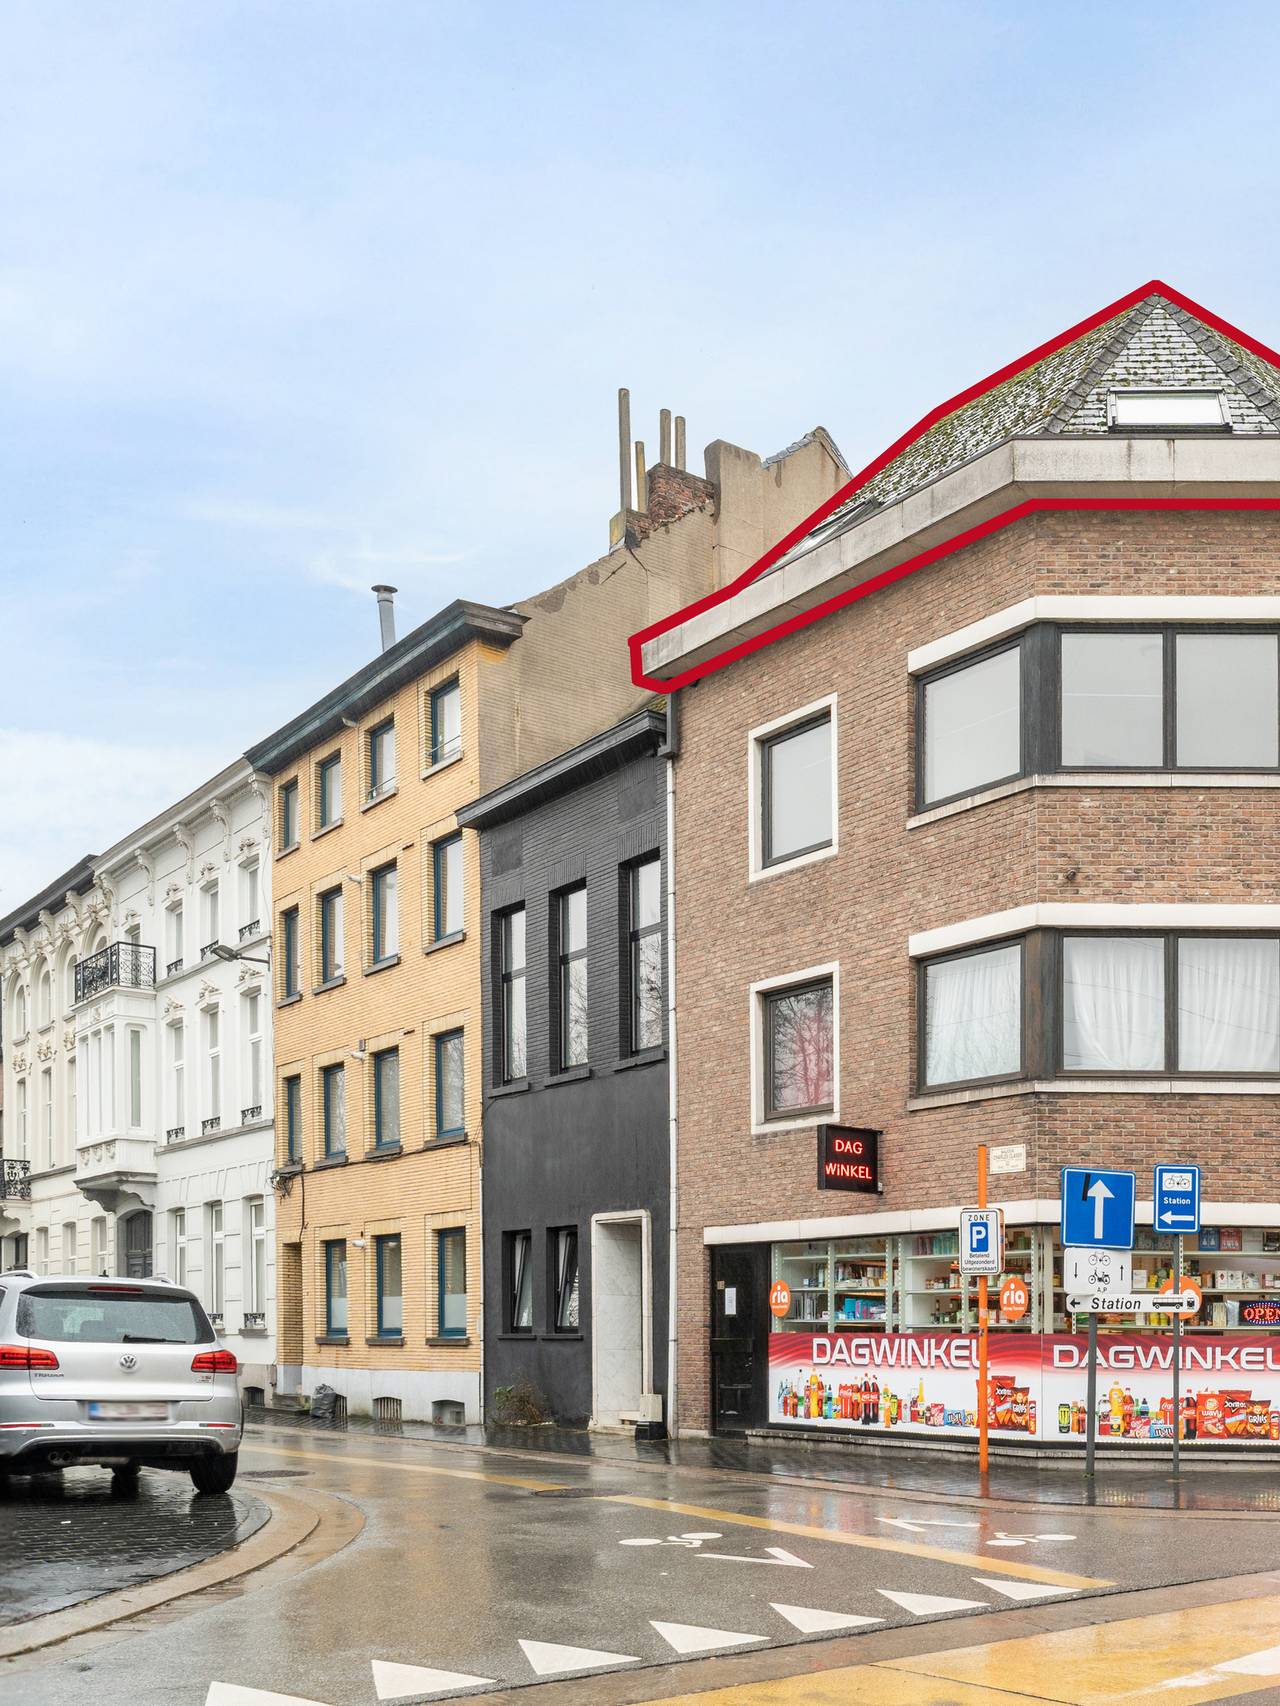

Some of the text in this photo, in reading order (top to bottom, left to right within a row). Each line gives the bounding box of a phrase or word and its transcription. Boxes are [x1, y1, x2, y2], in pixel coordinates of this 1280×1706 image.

[834, 1139, 863, 1154] DAG
[1163, 1196, 1191, 1205] Station
[972, 1226, 987, 1249] P
[771, 1284, 789, 1304] ria
[1003, 1282, 1025, 1305] ria
[1091, 1297, 1141, 1310] Station
[812, 1337, 991, 1369] DAGWINKEL
